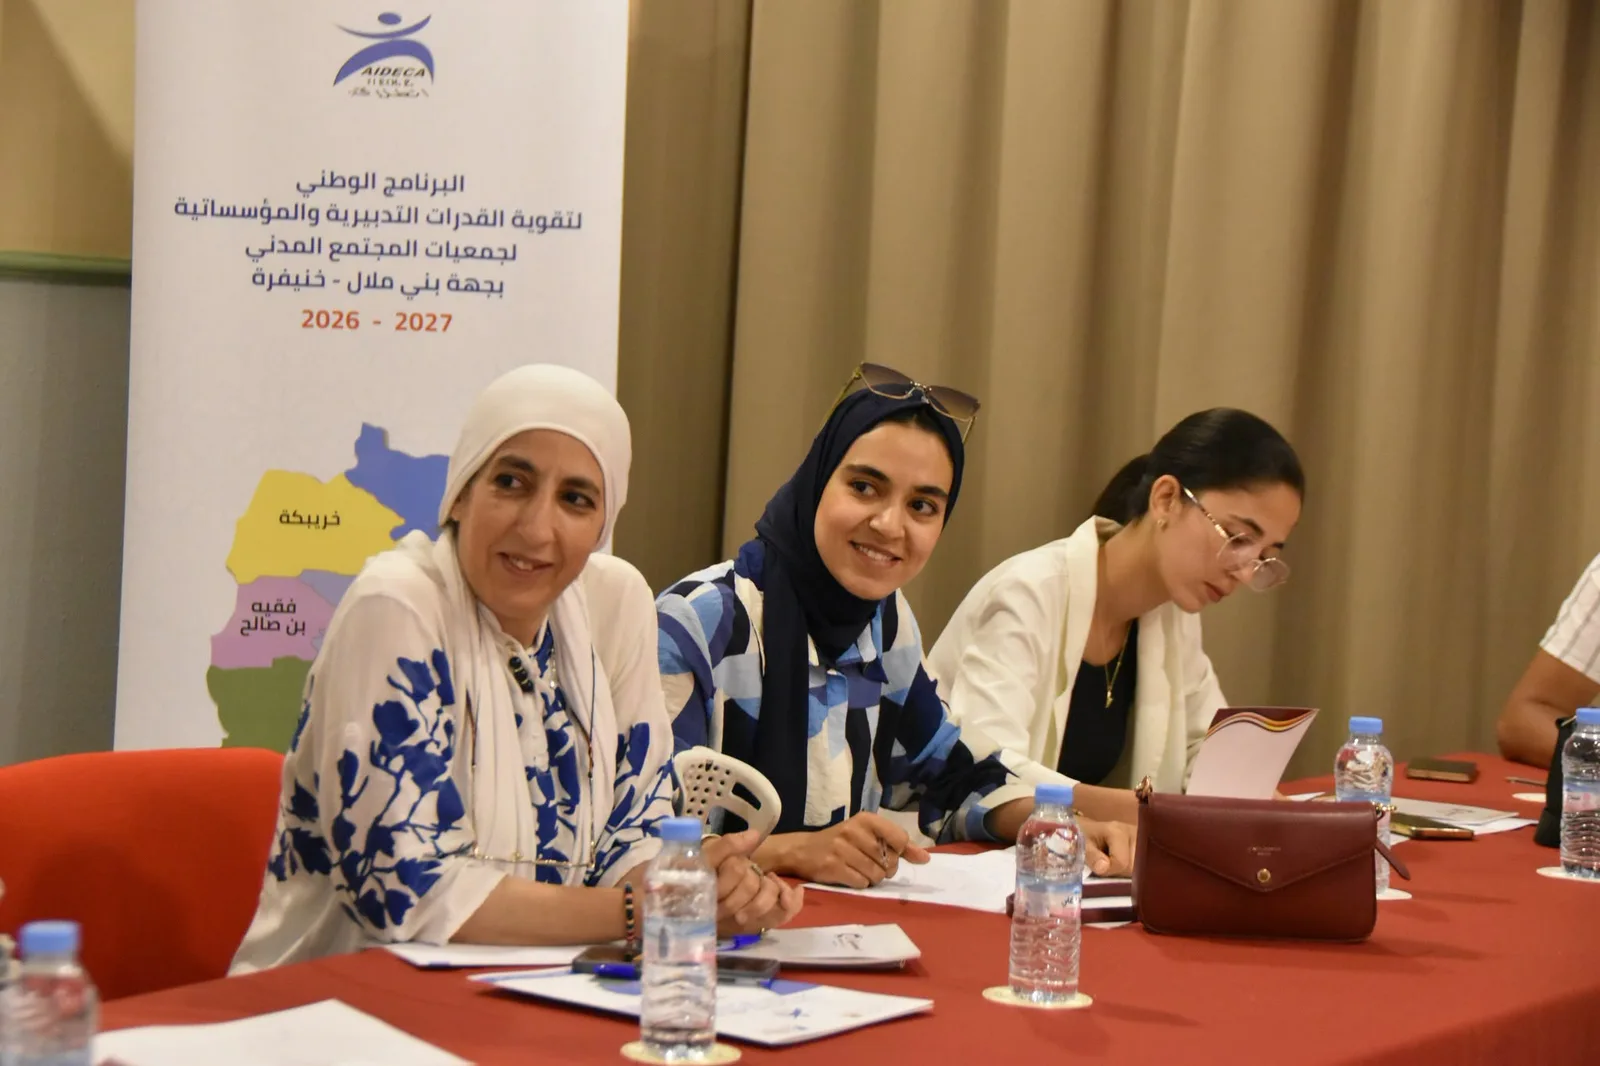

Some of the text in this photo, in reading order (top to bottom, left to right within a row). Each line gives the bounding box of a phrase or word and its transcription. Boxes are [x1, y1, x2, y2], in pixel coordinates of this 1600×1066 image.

[361, 66, 425, 77] AIDECA
[296, 170, 465, 199] البرنامج الوطني
[174, 196, 583, 235] لتقوية القدرات التدبيرية والمؤسساتية
[245, 235, 517, 266] لجمعيات المجتمع المدني
[252, 267, 326, 292] خنيفرة
[347, 271, 395, 296] ملال
[400, 272, 440, 301] بني
[447, 273, 504, 299] بجهة
[301, 309, 360, 330] 2026
[394, 311, 453, 333] 2027
[278, 509, 341, 531] خريبكة
[251, 599, 297, 618] فقيه
[239, 616, 306, 637] بن صالح
